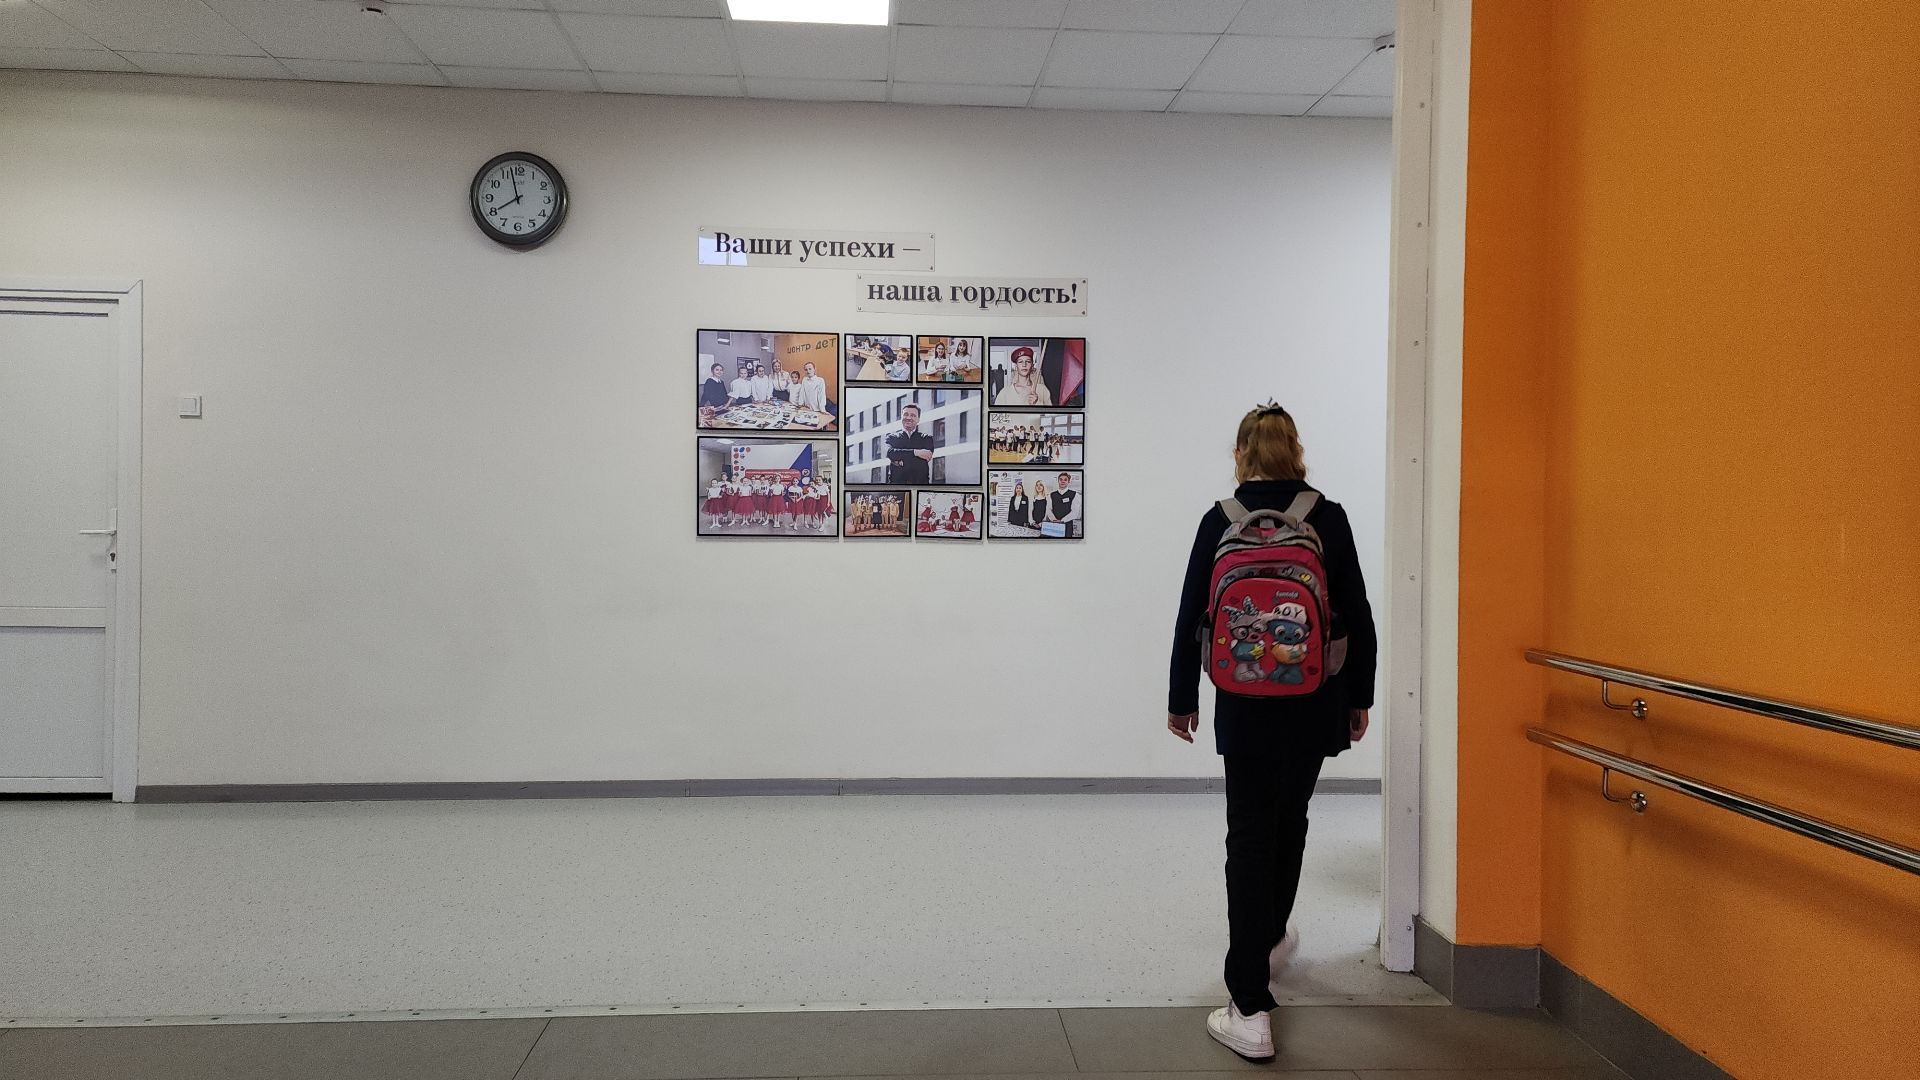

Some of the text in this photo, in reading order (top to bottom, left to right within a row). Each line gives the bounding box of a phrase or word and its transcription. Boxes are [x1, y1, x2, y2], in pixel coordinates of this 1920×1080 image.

[715, 232, 791, 255] Ваши
[799, 238, 894, 263] успехи
[867, 283, 1078, 309] наша гордость!
